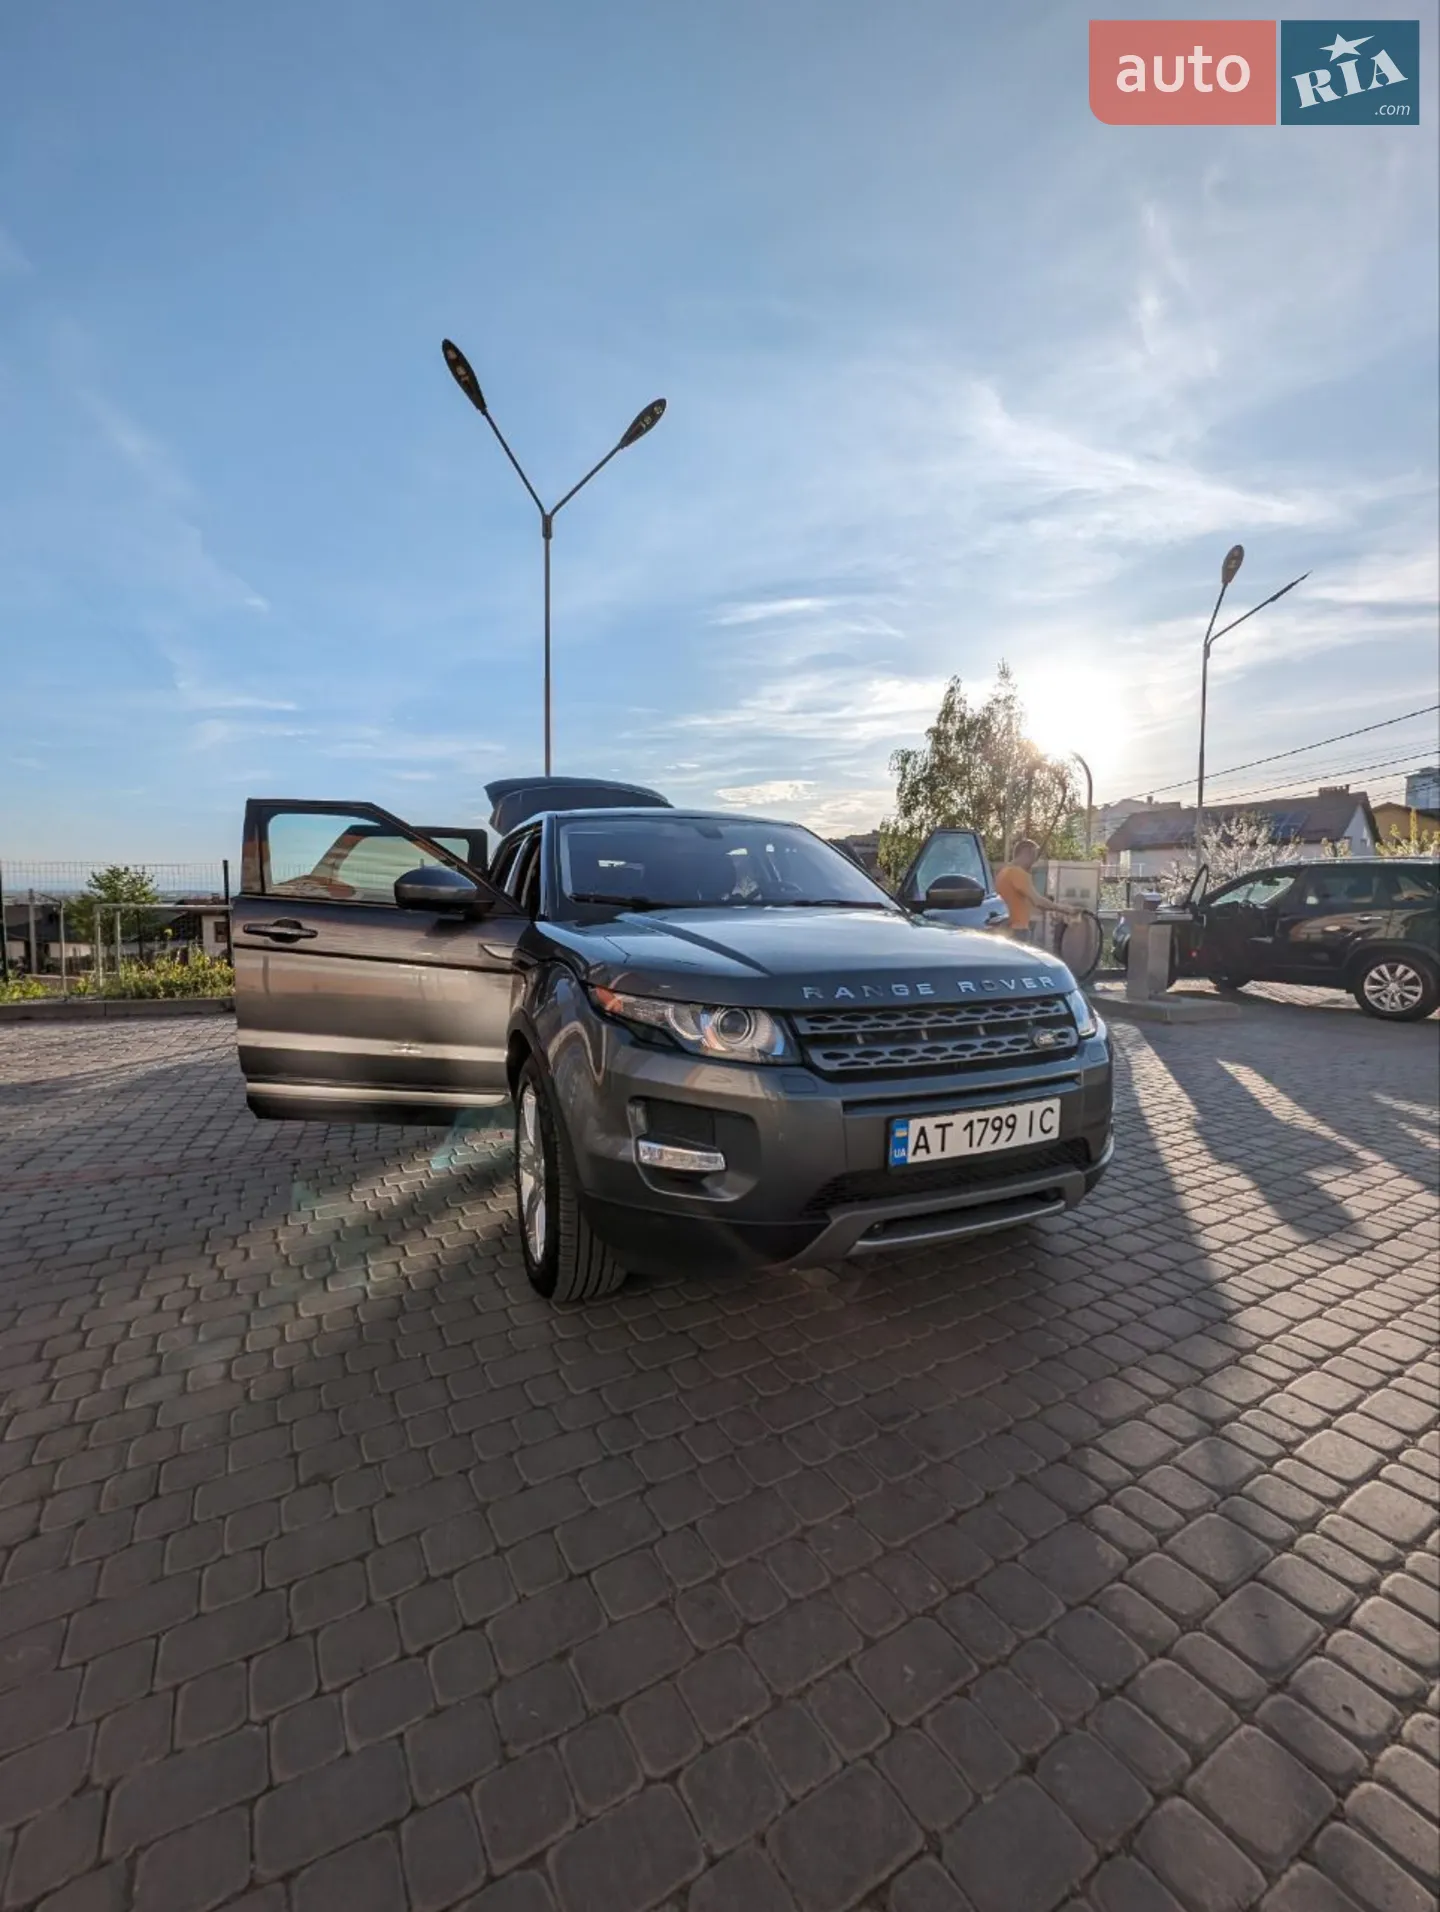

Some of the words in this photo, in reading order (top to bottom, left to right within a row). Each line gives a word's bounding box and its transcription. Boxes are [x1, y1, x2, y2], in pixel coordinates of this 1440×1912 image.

[802, 983, 935, 1000] RANGE
[957, 975, 1056, 993] ROVER
[911, 1122, 953, 1157] AT
[962, 1113, 1017, 1149] 1799
[1027, 1107, 1055, 1138] IC
[893, 1149, 906, 1159] UA
